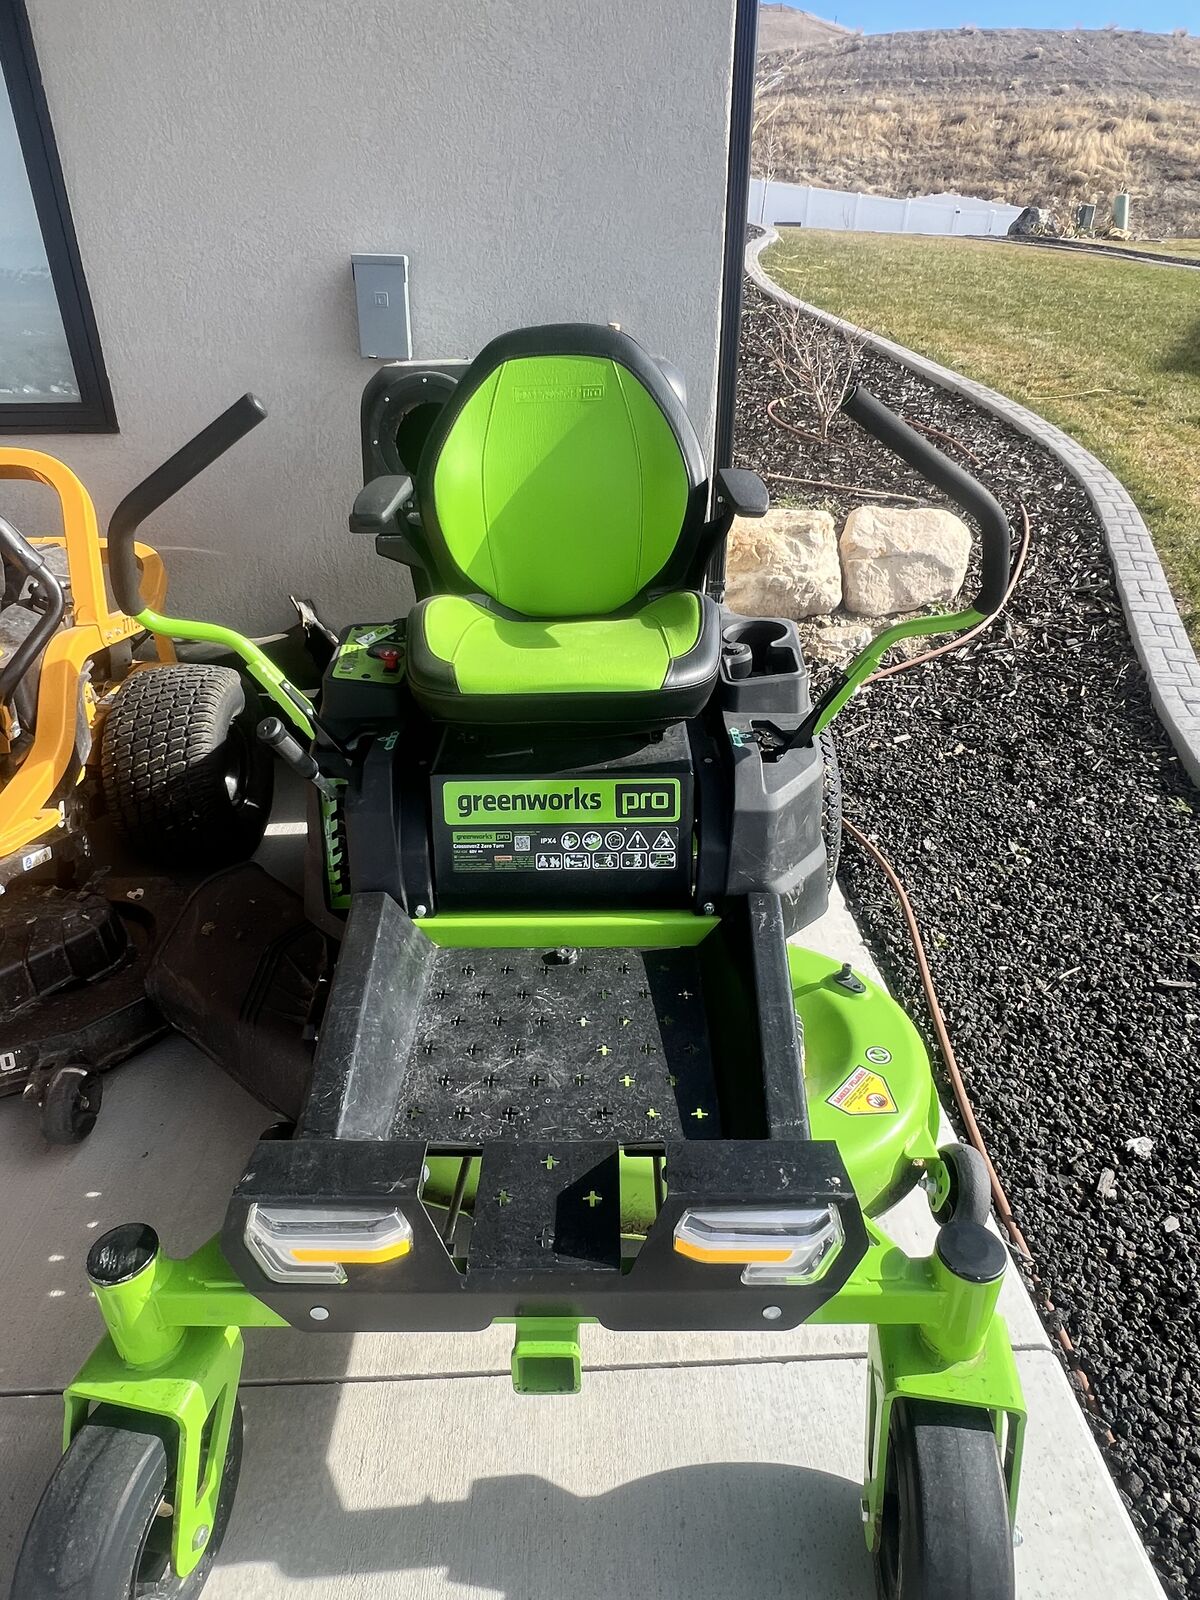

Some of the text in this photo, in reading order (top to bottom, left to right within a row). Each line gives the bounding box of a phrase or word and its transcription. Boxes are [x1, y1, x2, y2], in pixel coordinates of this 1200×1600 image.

[457, 786, 669, 818] greenworks pro
[456, 833, 493, 841] greenworks
